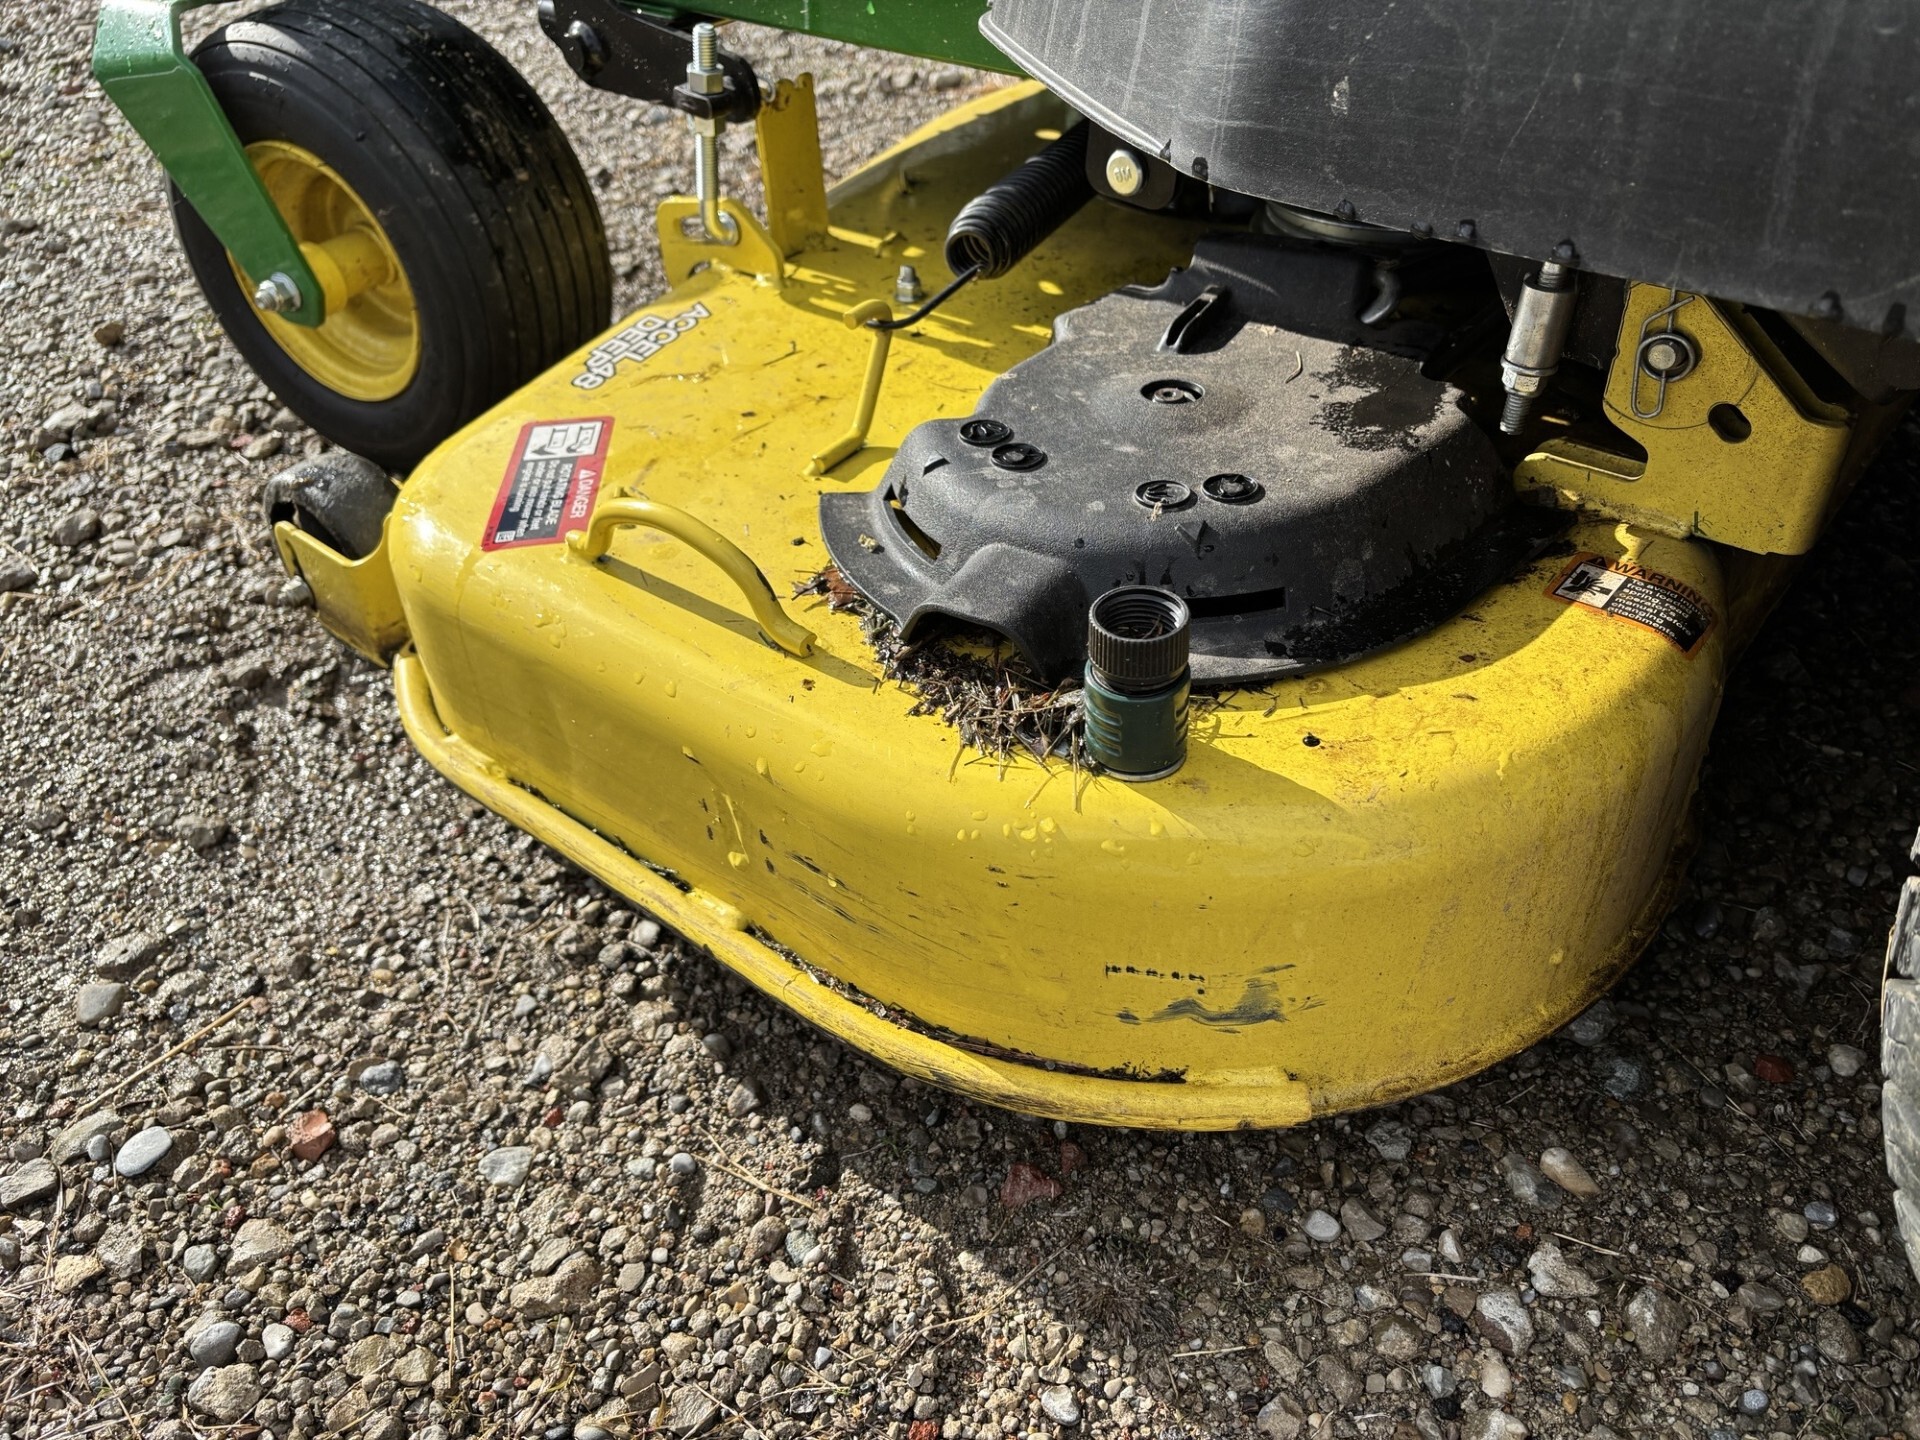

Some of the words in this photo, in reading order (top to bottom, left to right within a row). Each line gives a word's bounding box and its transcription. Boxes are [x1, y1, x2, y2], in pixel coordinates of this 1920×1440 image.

[585, 315, 666, 371] DEEP
[611, 301, 711, 363] ACCEL
[571, 361, 615, 390] 48
[552, 462, 573, 498] ROTATING
[569, 478, 594, 518] DANGER
[544, 498, 563, 525] BLADE
[1614, 561, 1715, 619] WARNING
[1619, 592, 1676, 617] operator's
[1627, 583, 1654, 595] from
[1655, 592, 1693, 615] loaded
[1631, 578, 1645, 588] To
[1646, 584, 1678, 599] avoid
[1680, 597, 1706, 621] injury
[1611, 602, 1664, 625] changing
[1614, 597, 1658, 614] manual
[1659, 611, 1692, 637] before
[1664, 602, 1689, 619] read
